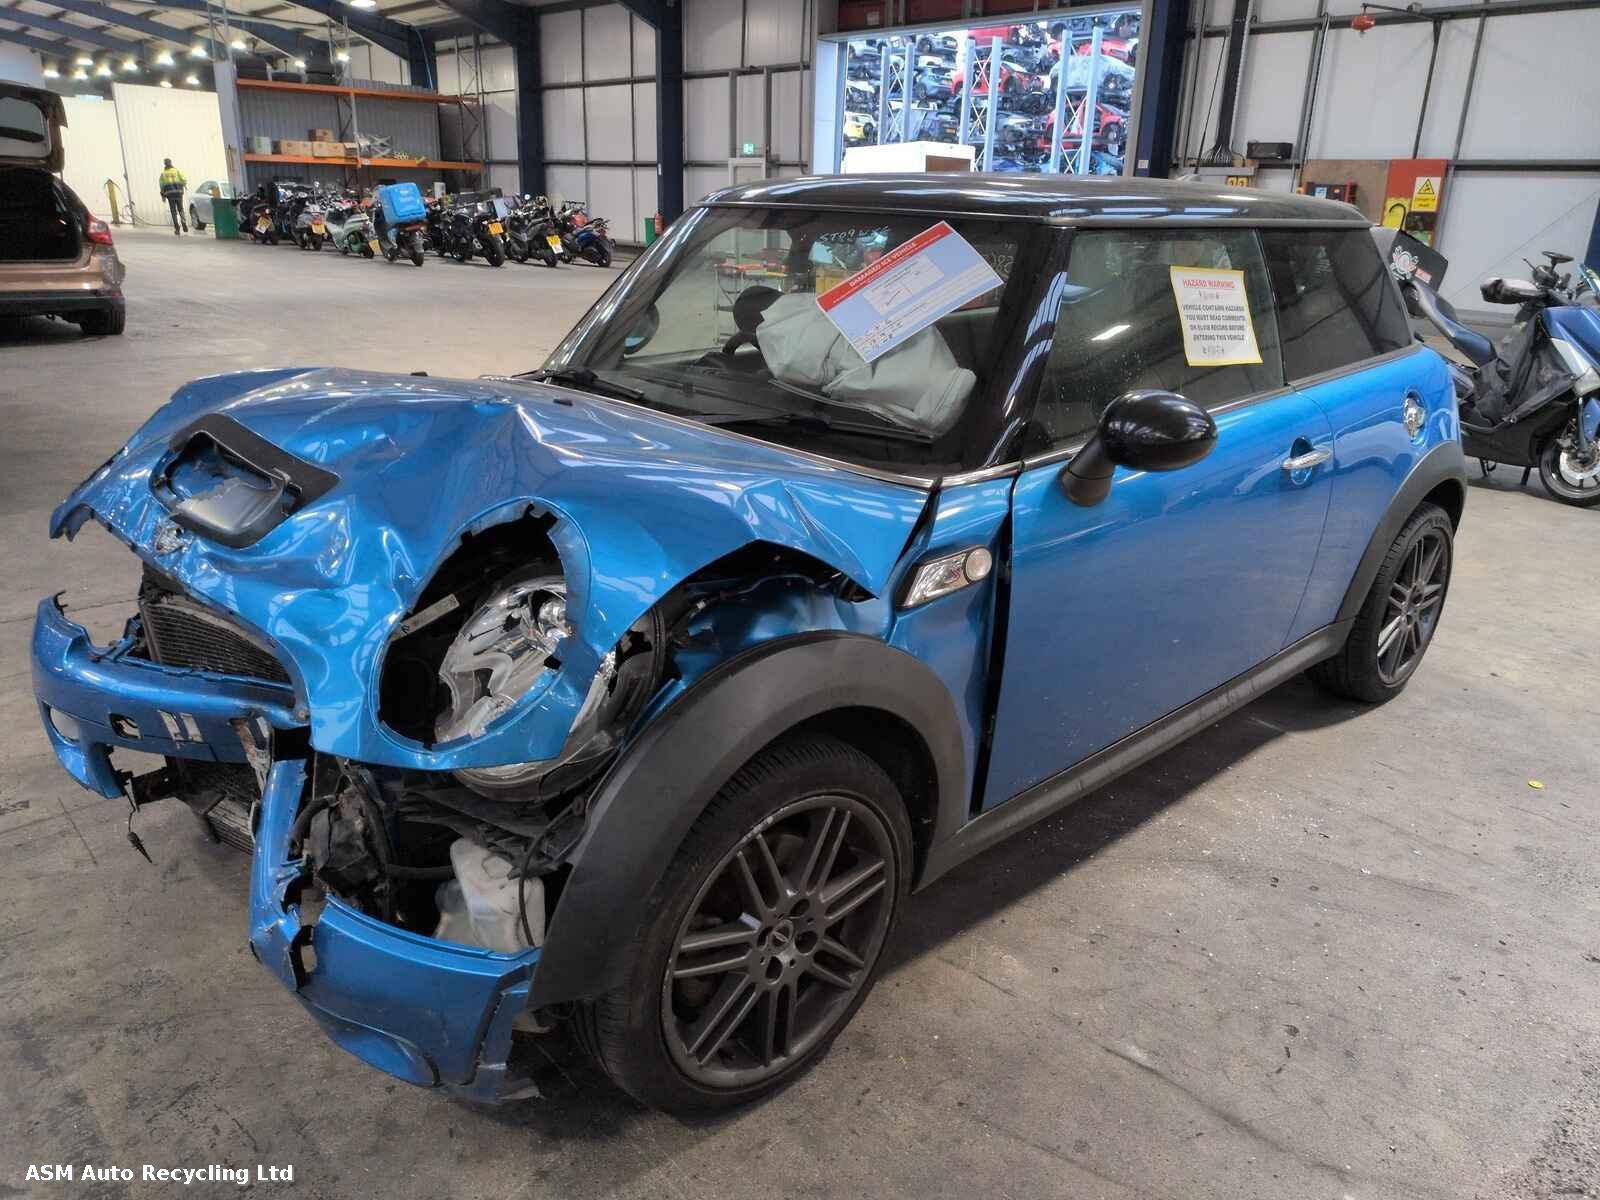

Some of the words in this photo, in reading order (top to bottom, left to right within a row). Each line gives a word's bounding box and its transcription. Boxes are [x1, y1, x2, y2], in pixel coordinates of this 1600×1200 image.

[849, 263, 881, 288] DAMAGED
[892, 242, 918, 260] VEHICLE
[1183, 279, 1208, 288] HAZARD
[1208, 280, 1235, 289] WARNING
[1183, 303, 1202, 311] VEHICLE
[1202, 304, 1225, 312] CONTAINS
[1210, 314, 1222, 322] READ
[1193, 334, 1215, 342] ENTERING
